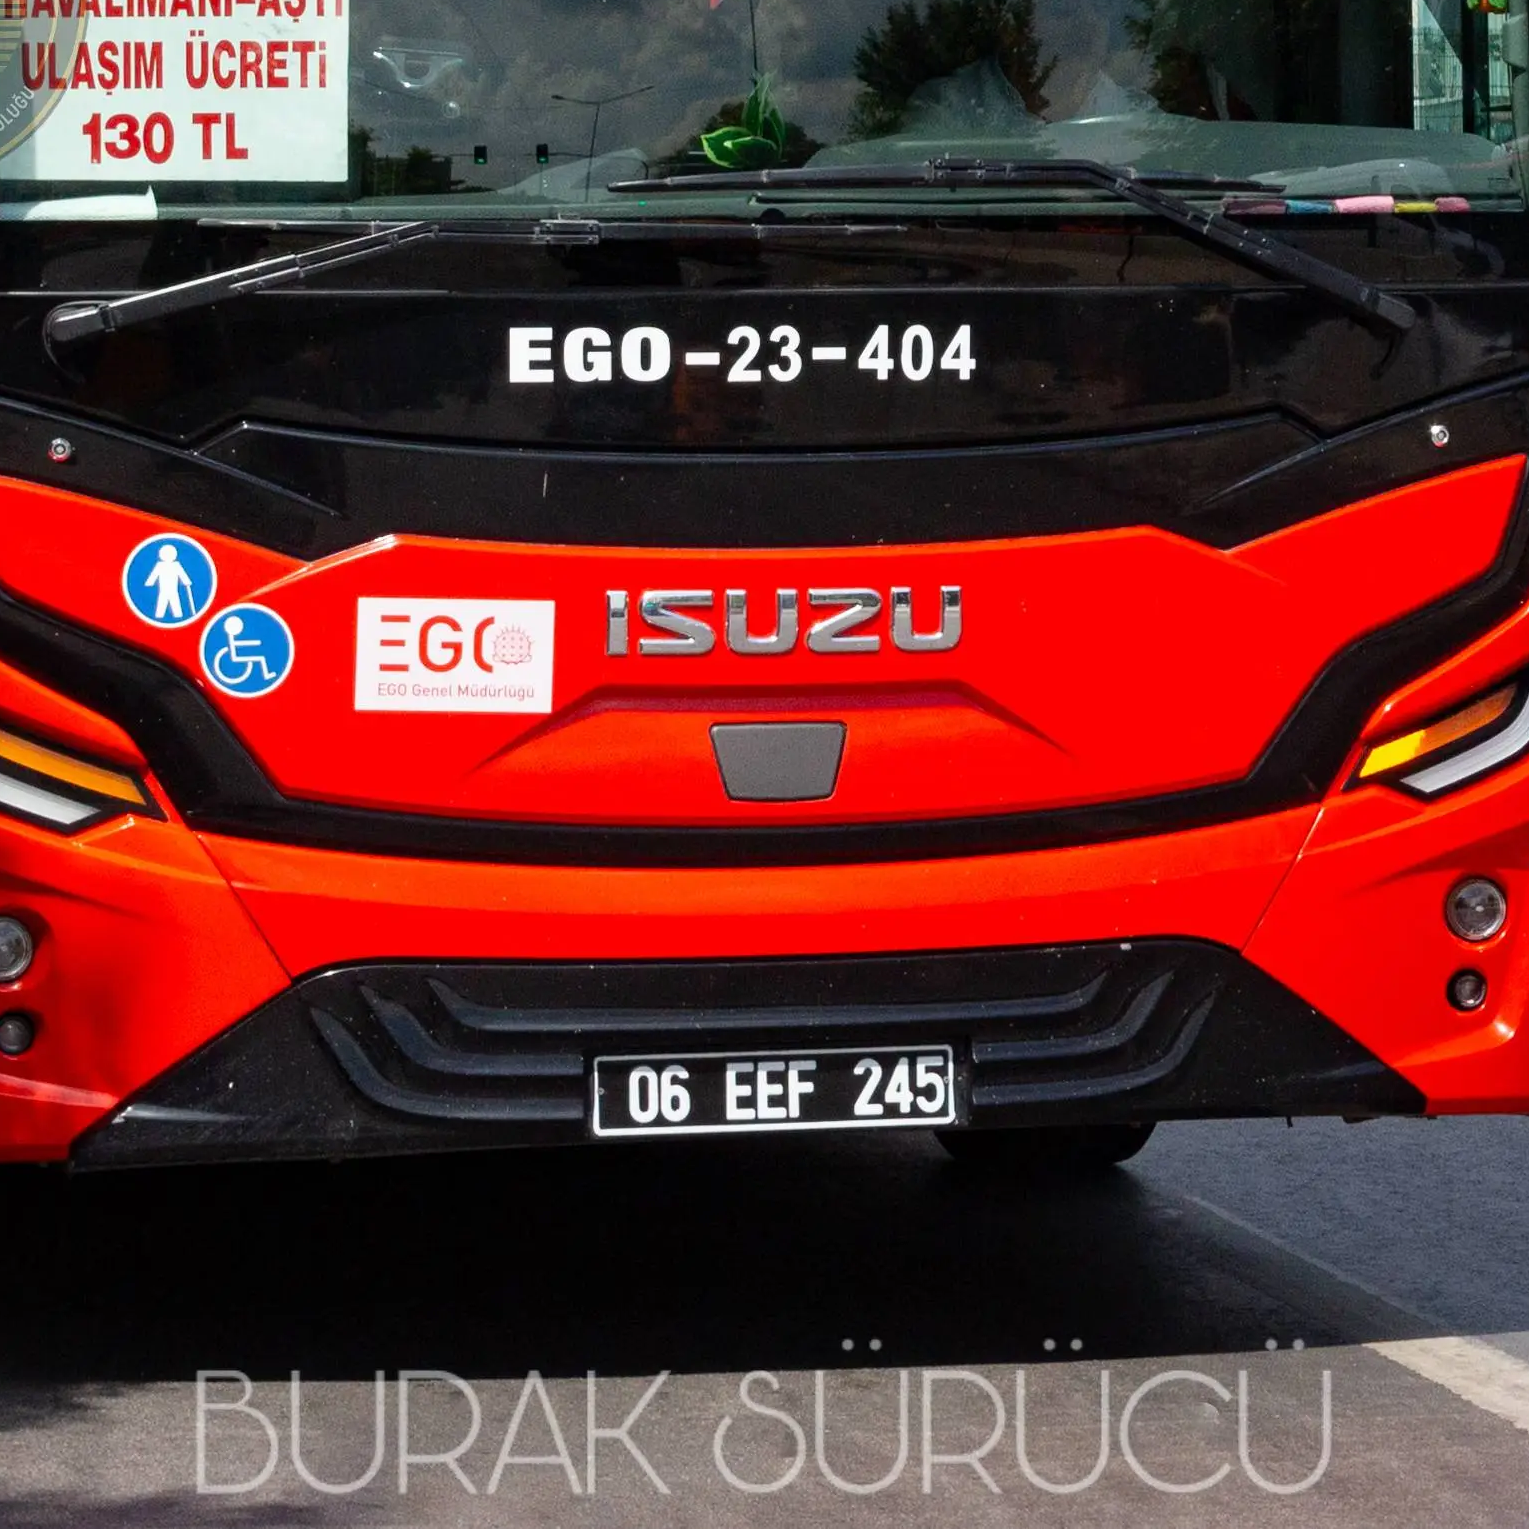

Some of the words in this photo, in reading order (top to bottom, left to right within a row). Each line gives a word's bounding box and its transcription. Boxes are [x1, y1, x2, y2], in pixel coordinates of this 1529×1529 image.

[22, 40, 163, 96] ULAŞIM
[185, 29, 328, 89] ÜCRETİ
[82, 111, 175, 164] 130
[192, 112, 249, 161] TL
[508, 324, 977, 383] EGO-23-404
[604, 584, 964, 656] ISUZU
[377, 682, 407, 697] EGO
[411, 682, 452, 698] Genel
[628, 1064, 691, 1124] 06
[725, 1059, 817, 1121] EEF
[853, 1055, 946, 1118] 245
